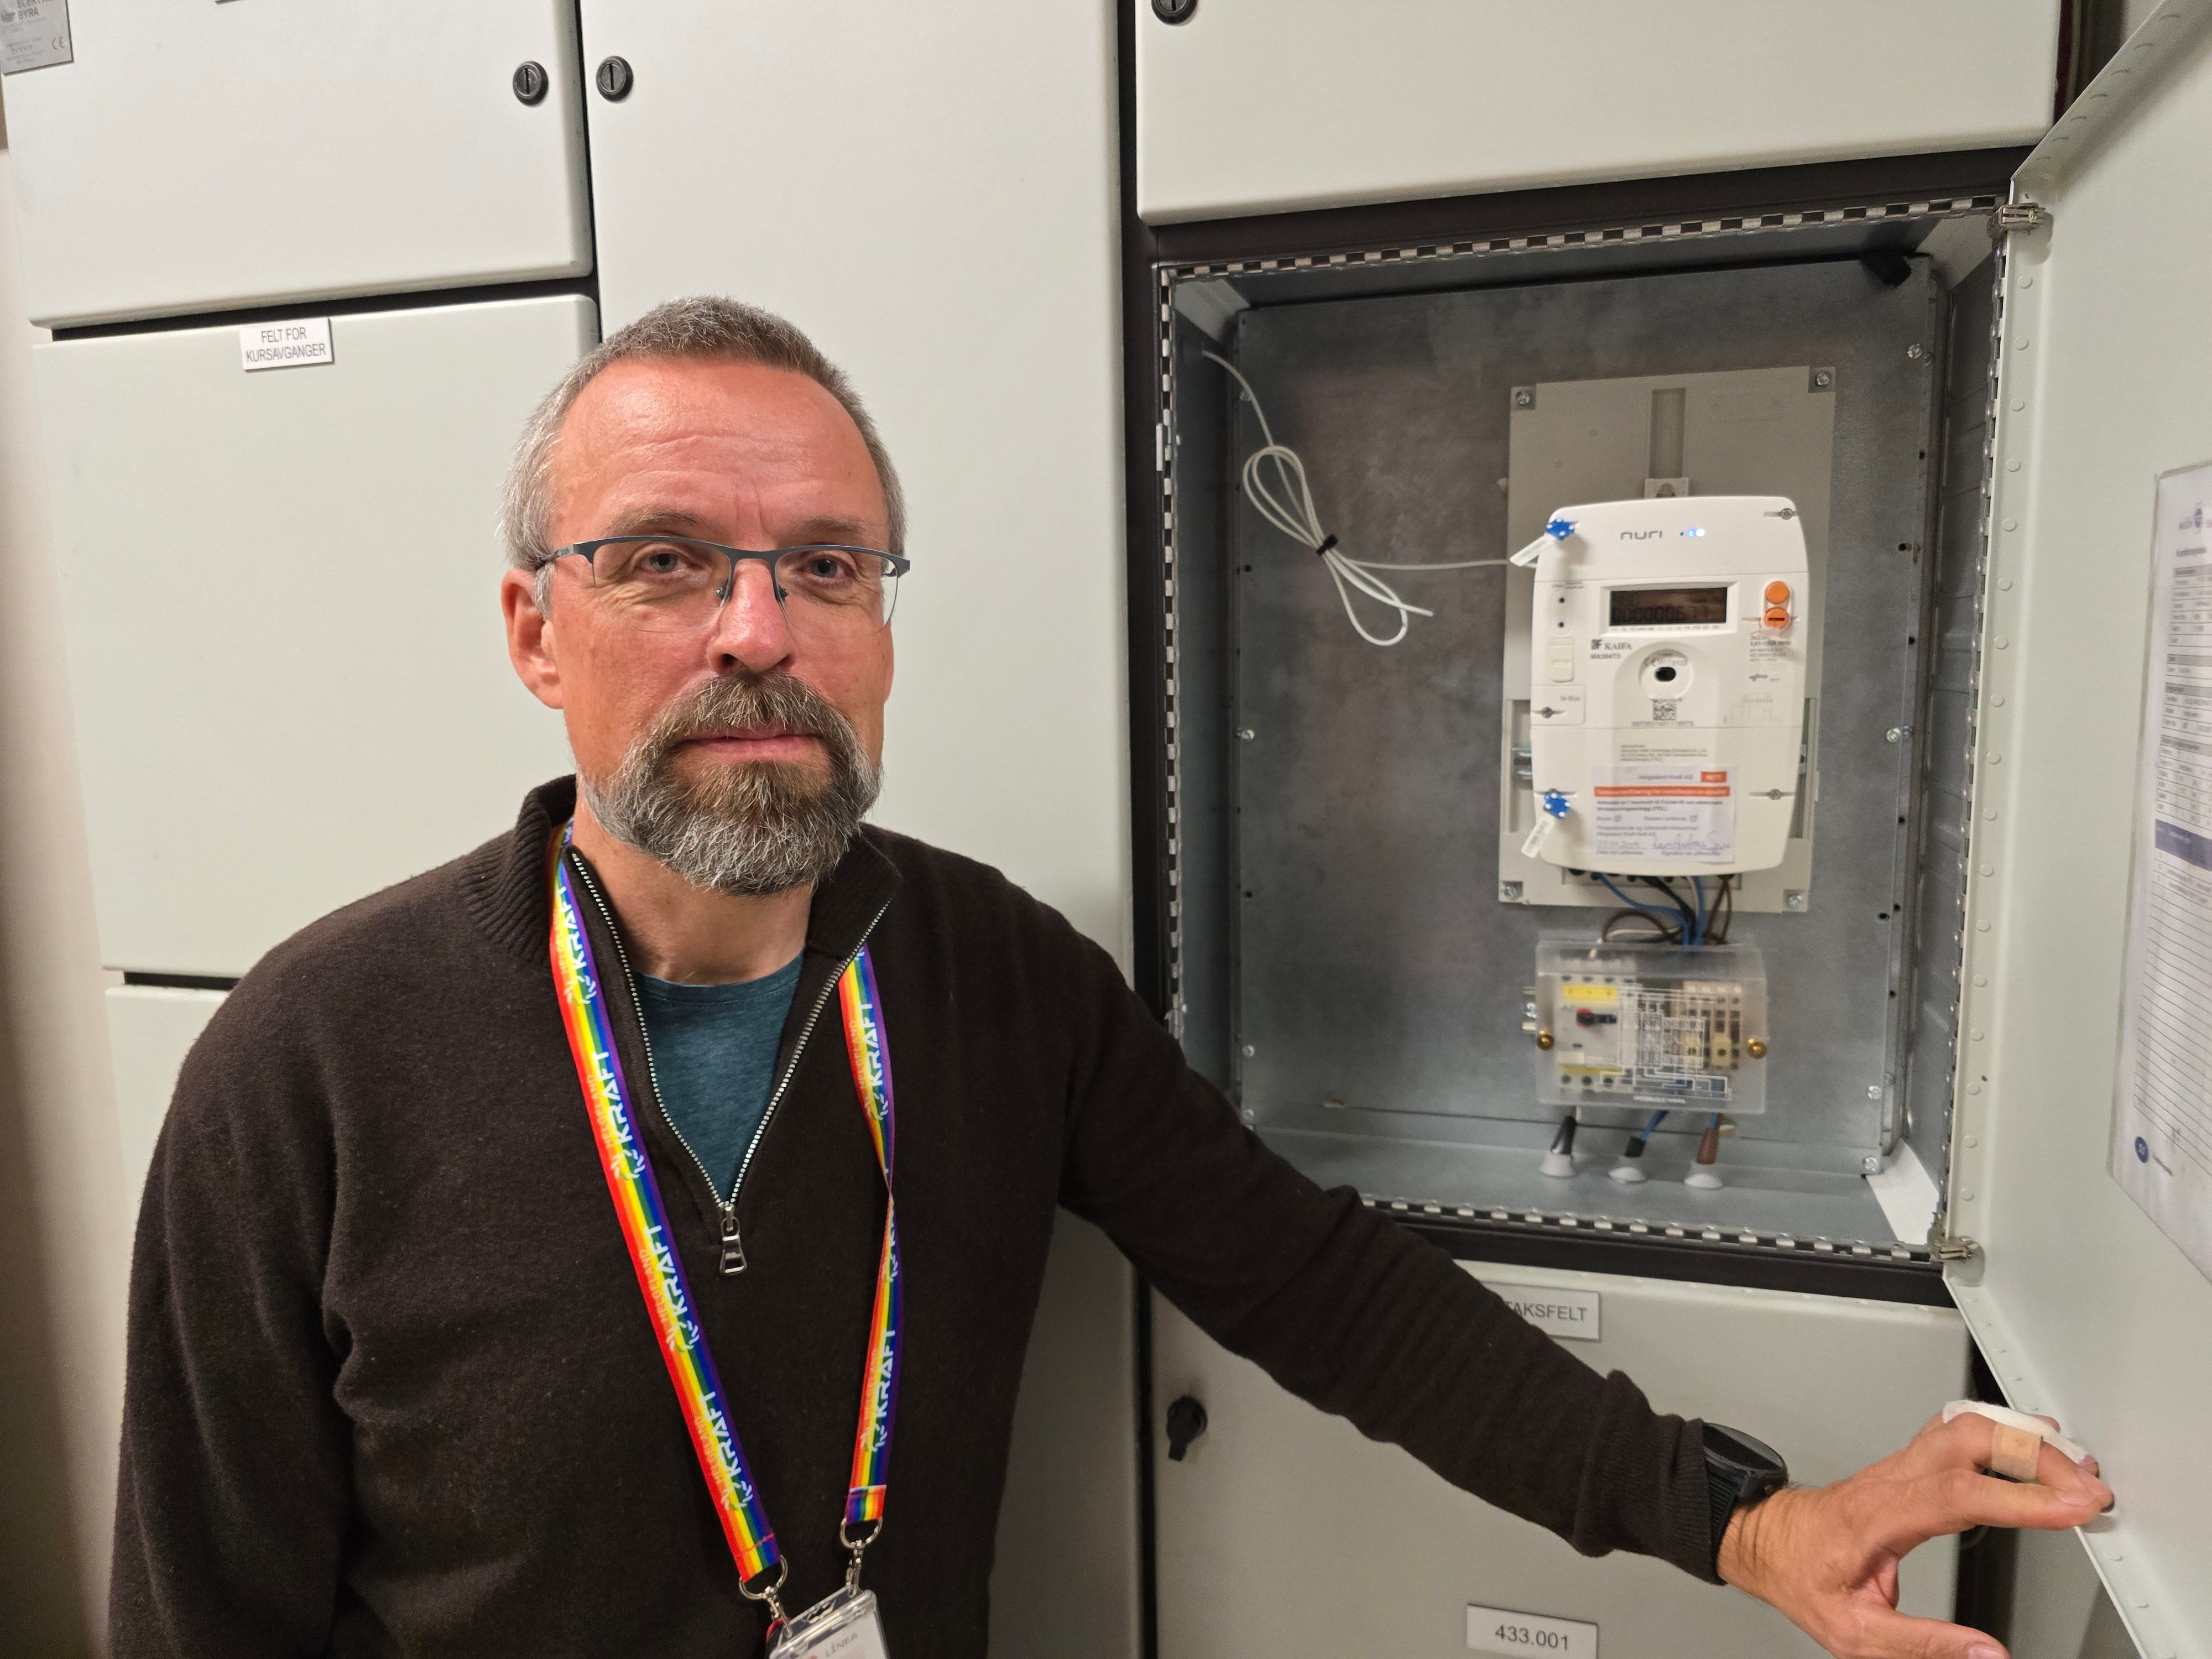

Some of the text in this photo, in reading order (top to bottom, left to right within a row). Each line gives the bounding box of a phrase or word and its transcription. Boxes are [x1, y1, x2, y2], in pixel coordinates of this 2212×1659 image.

[246, 343, 327, 363] KURSAVGANGER
[261, 327, 307, 343] FELT FOR
[555, 884, 587, 969] KRAFT
[858, 1001, 883, 1087] KRAFT
[592, 1051, 633, 1144] KRAFT
[644, 1225, 688, 1317] KRAFT
[875, 1327, 895, 1417] KRAFT
[699, 1391, 742, 1478] KRAFT
[1495, 1625, 1568, 1650] 433.001
